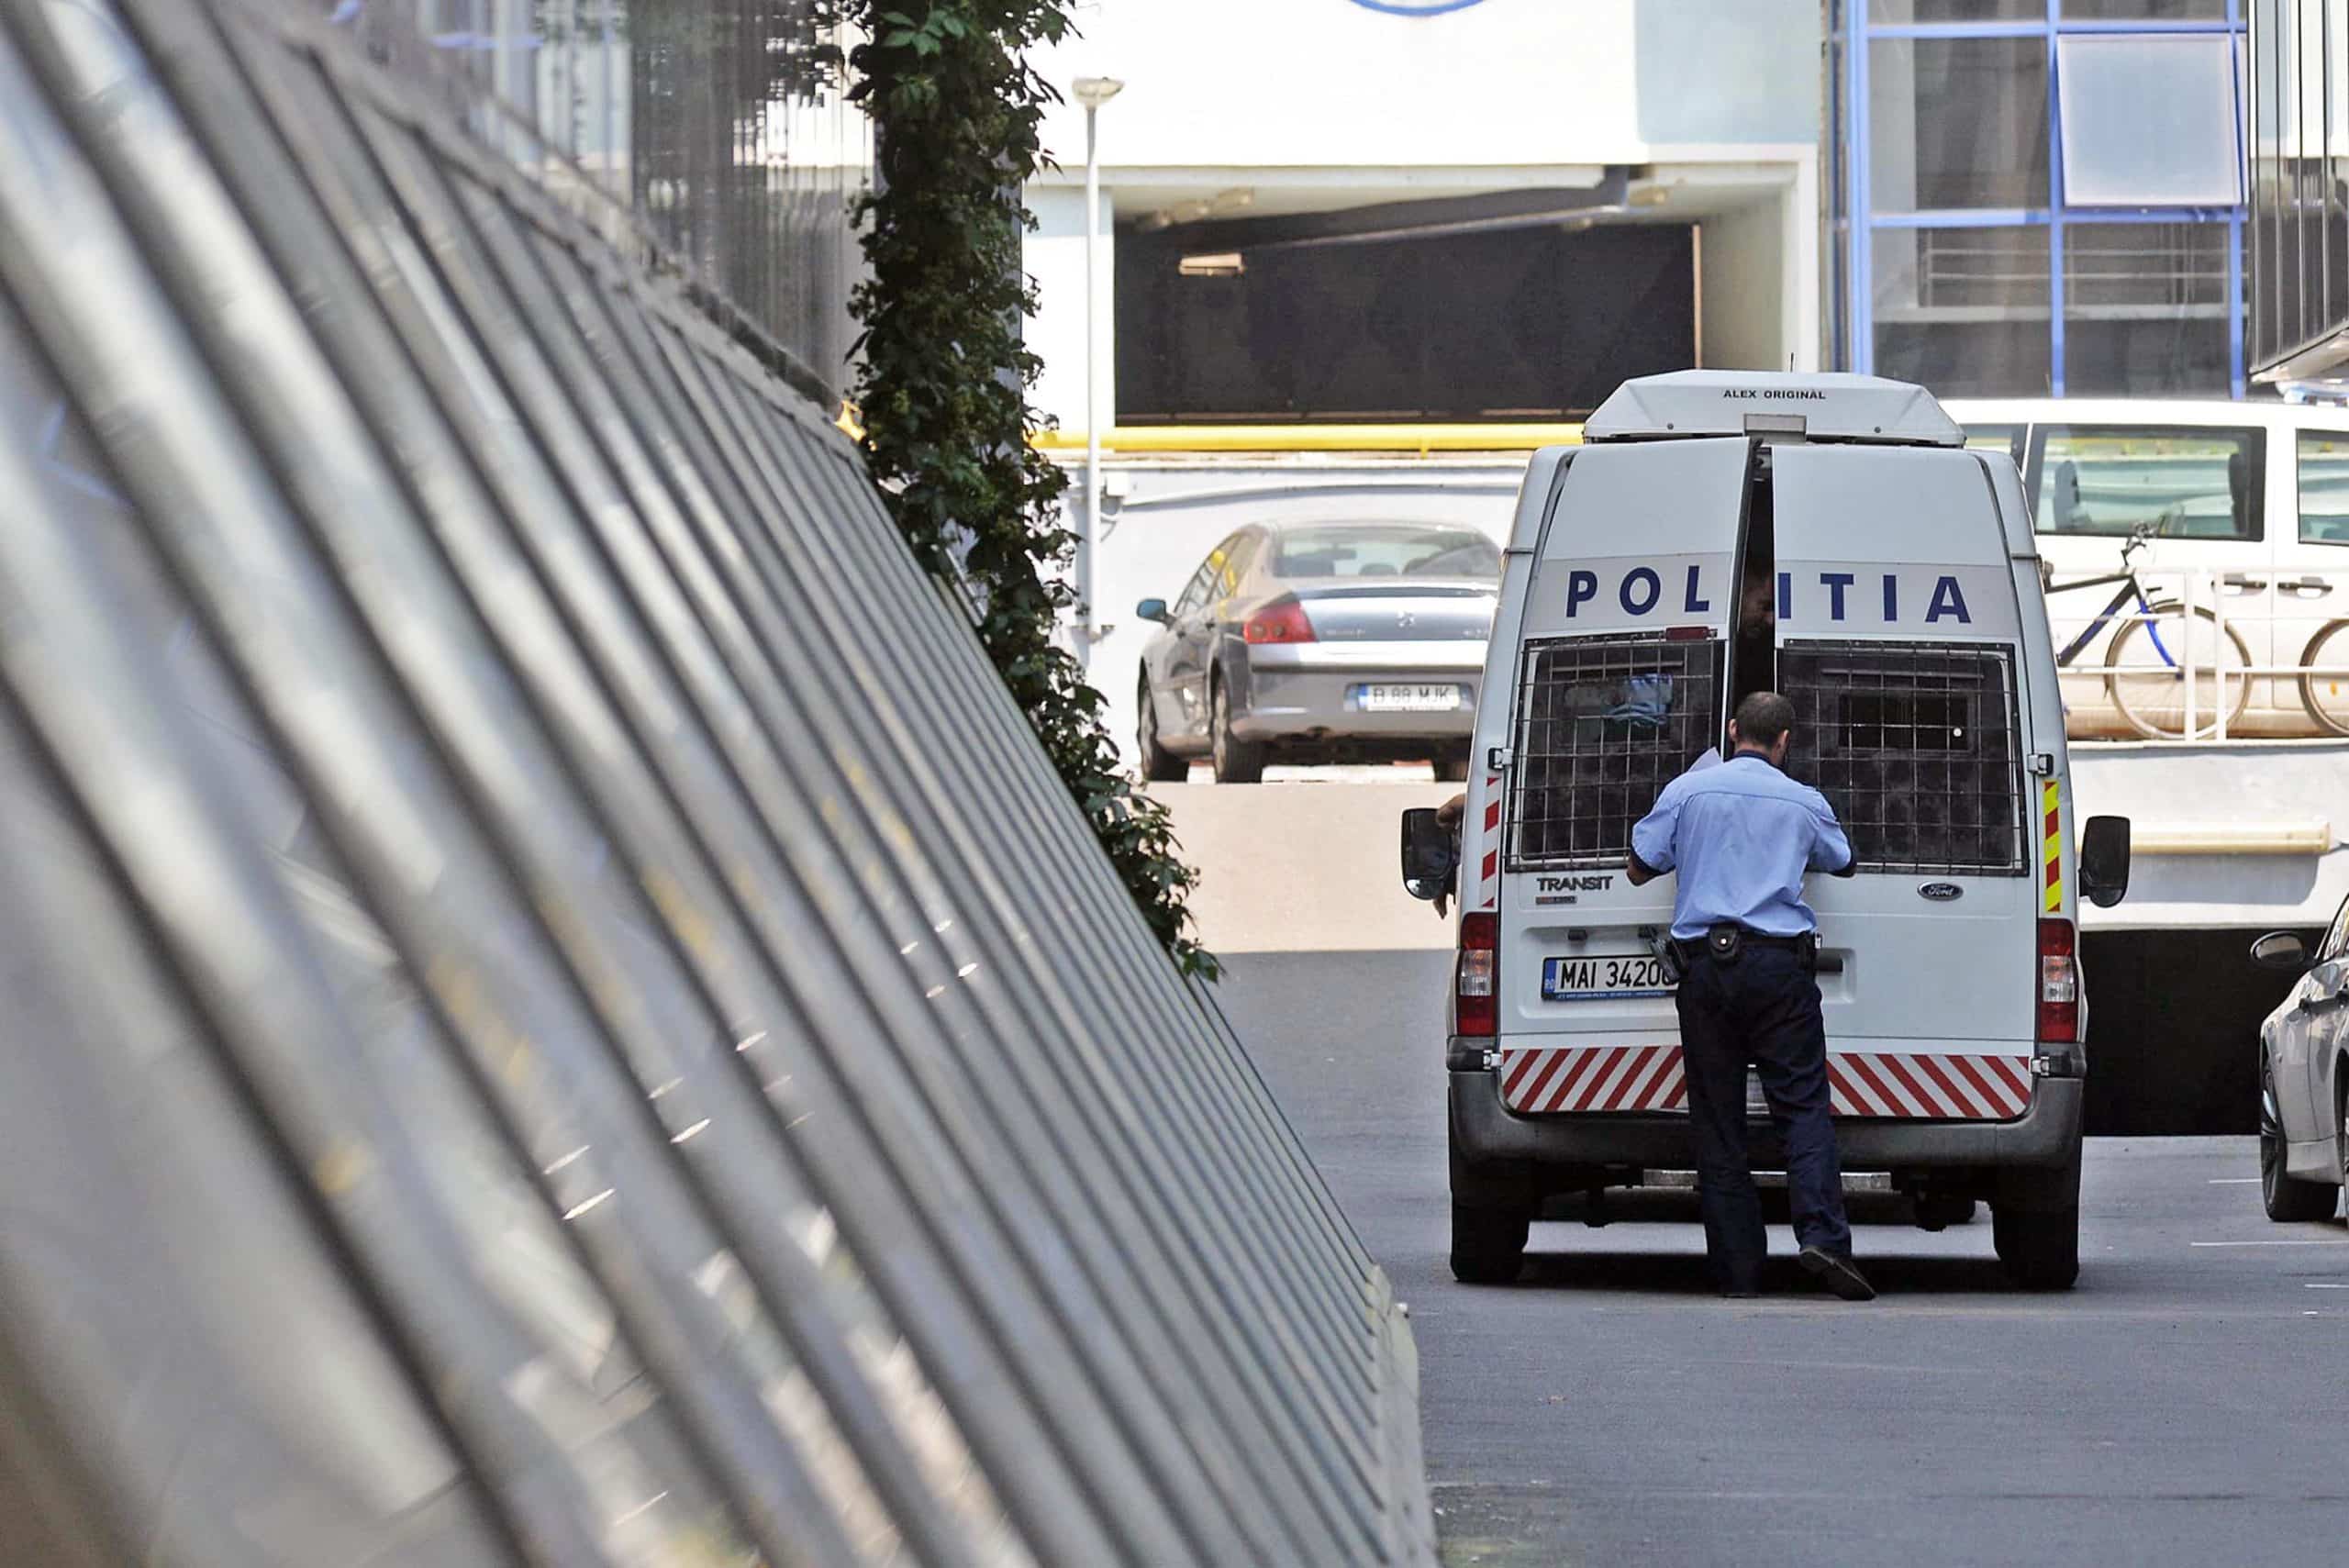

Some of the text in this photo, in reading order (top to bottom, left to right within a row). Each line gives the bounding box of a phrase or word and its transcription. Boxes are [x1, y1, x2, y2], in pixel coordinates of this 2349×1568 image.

[1723, 389, 1826, 400] ALEX ORIGINAL
[1536, 875, 1614, 892] TRANSIT
[1560, 962, 1597, 989] MAI
